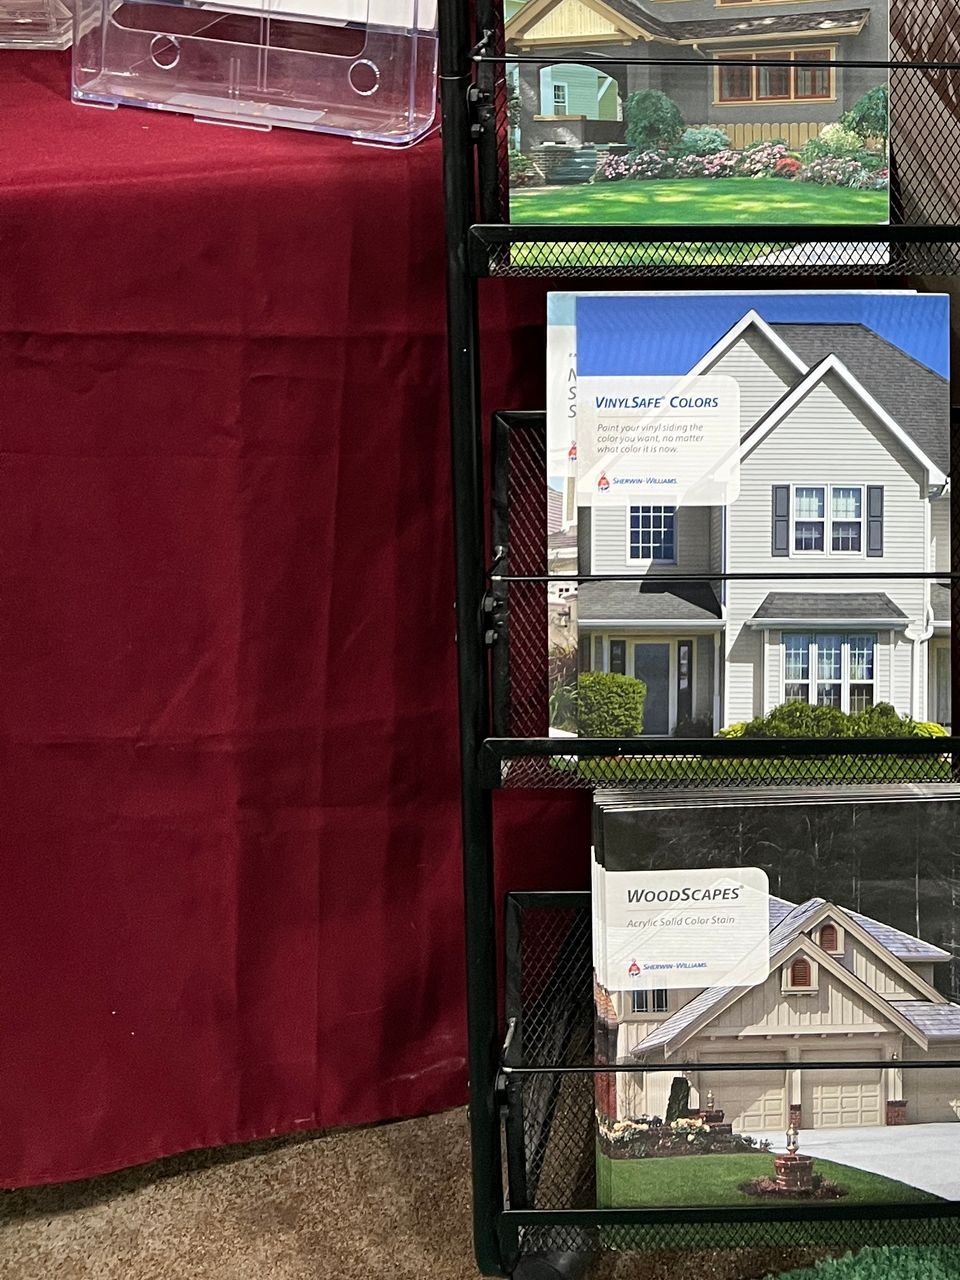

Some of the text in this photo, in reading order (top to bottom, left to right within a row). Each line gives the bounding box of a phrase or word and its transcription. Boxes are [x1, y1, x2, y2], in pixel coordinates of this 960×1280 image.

[669, 396, 719, 408] COLORS
[597, 423, 703, 433] Paint your vinyl siding the
[597, 434, 618, 443] color
[619, 436, 635, 444] you
[637, 436, 660, 444] want,
[676, 434, 704, 442] matter
[597, 445, 618, 453] what
[620, 445, 641, 453] color
[643, 445, 649, 453] it
[650, 445, 657, 453] is
[627, 915, 735, 928] Acrylic Solid Color Stain
